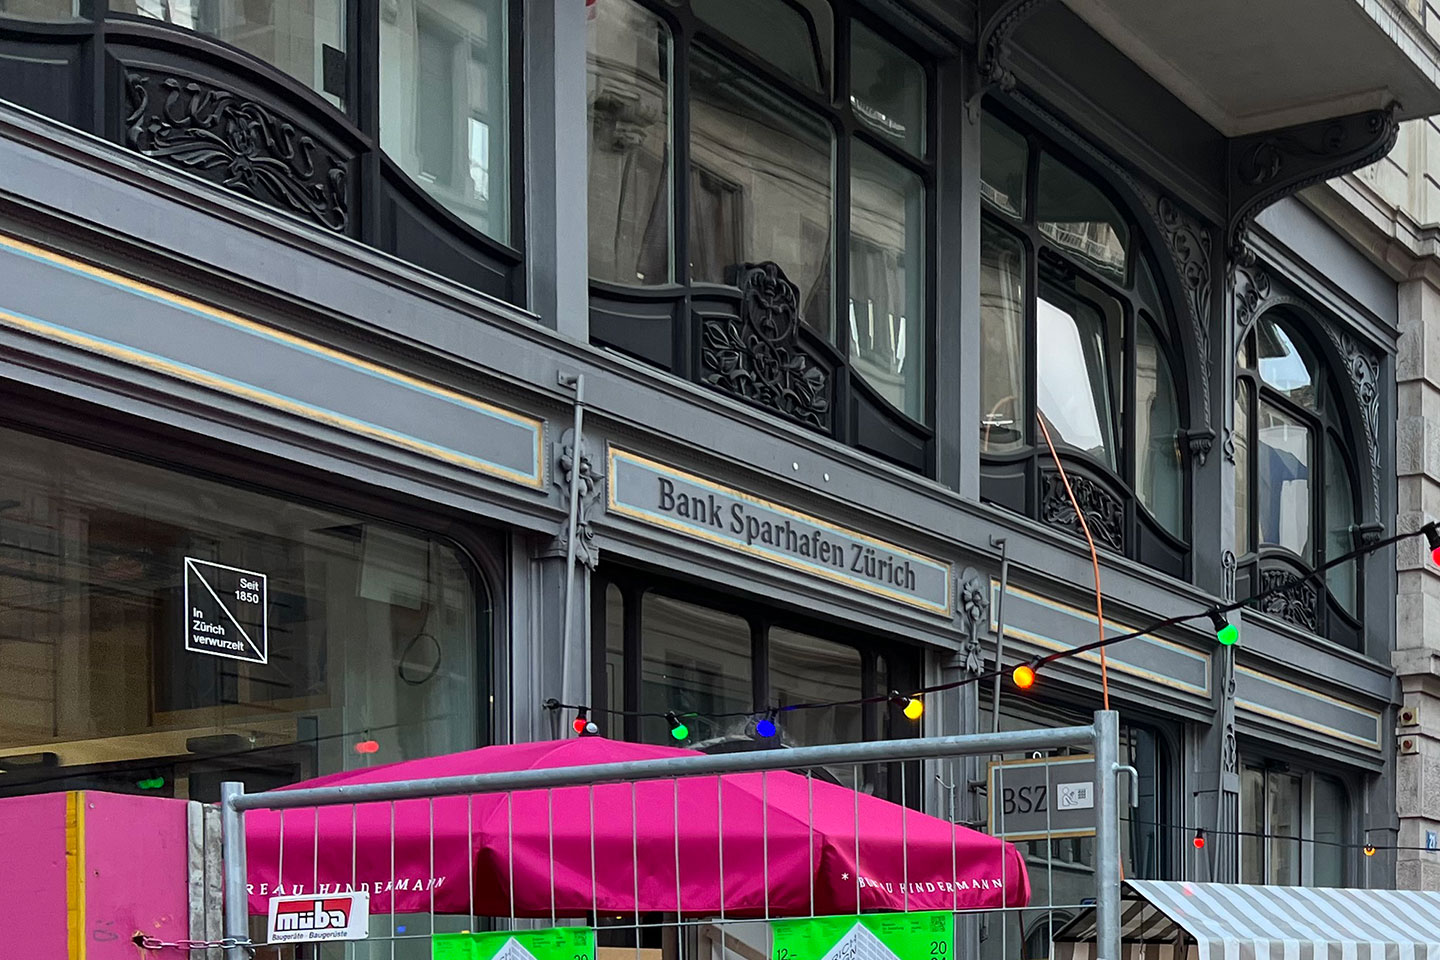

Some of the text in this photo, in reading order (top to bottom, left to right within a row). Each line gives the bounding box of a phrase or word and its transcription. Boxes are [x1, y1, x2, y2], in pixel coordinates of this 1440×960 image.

[656, 476, 916, 592] Bank Sparhafen Zürich
[239, 578, 260, 592] Seit
[235, 590, 259, 604] 1850
[192, 607, 203, 619] In
[192, 620, 226, 636] Zürich
[192, 634, 245, 652] verwurzelt
[1000, 785, 1049, 815] BSZ
[246, 883, 304, 896] REAU
[276, 900, 347, 931] müba
[930, 941, 947, 955] 20
